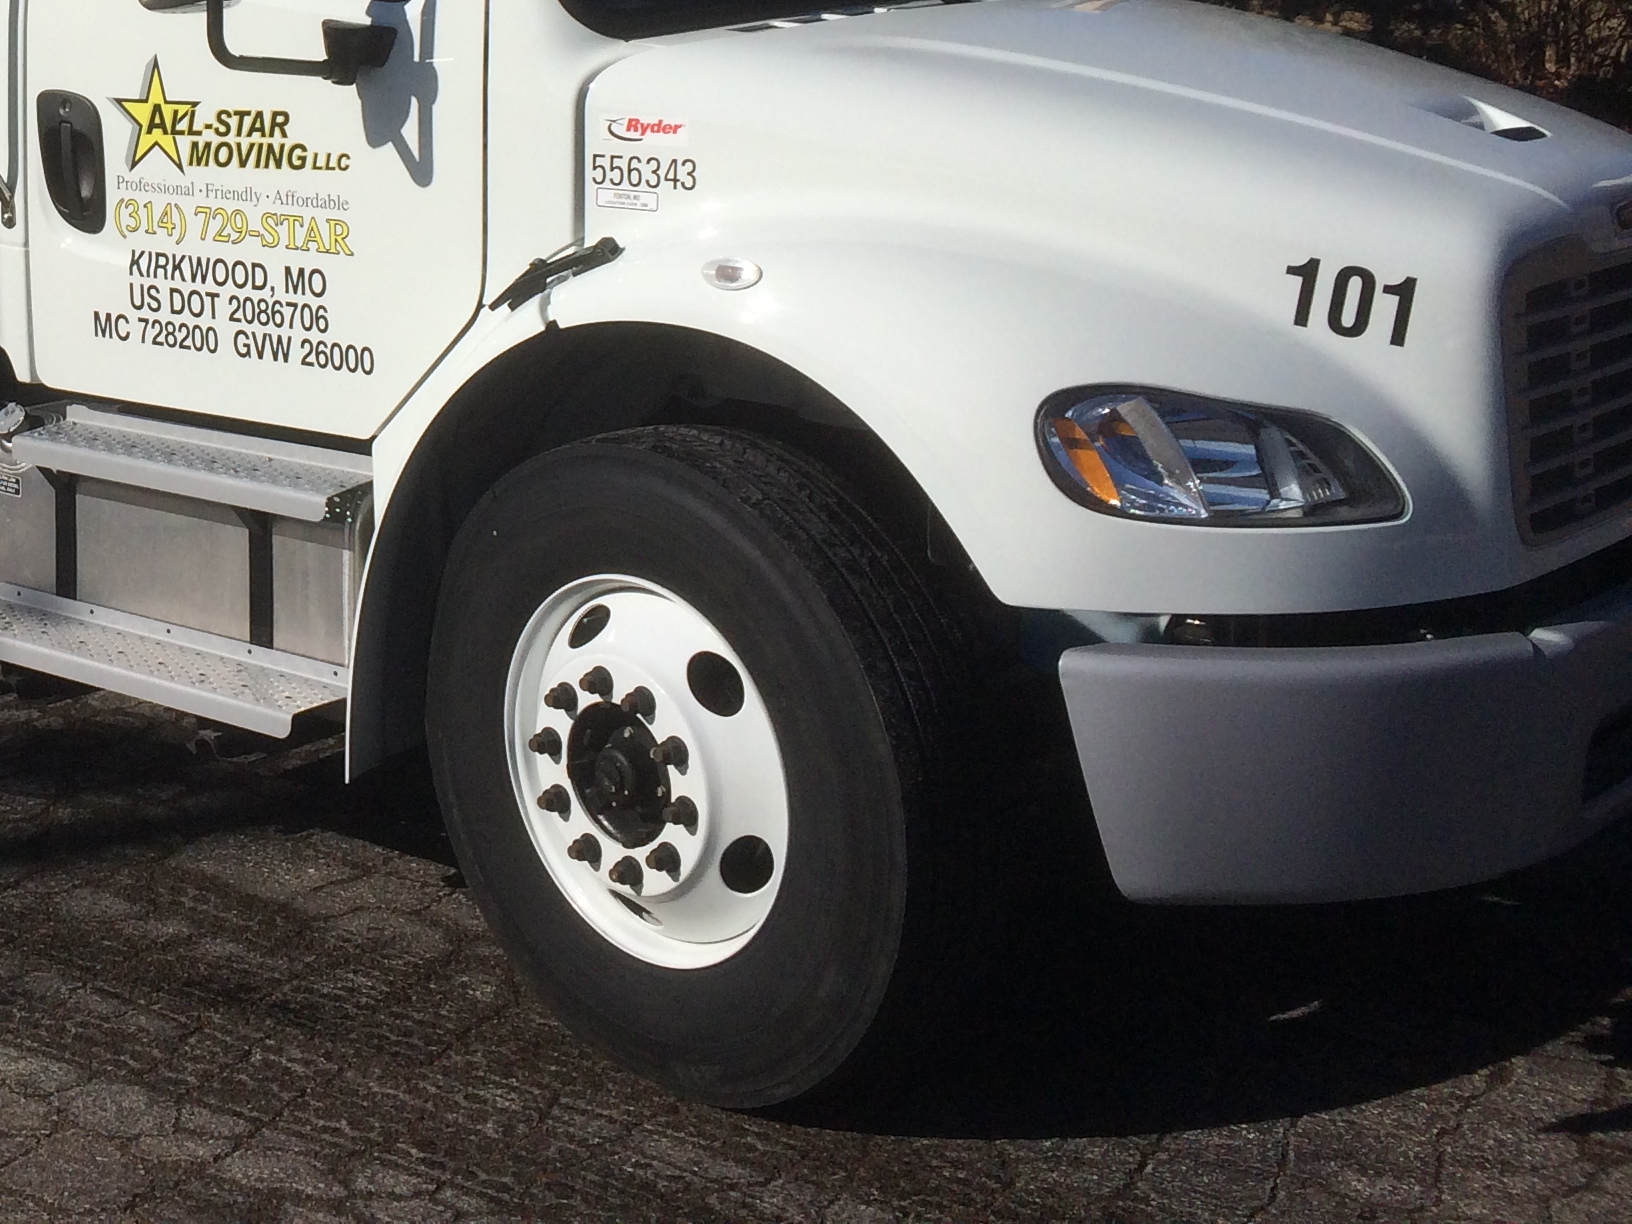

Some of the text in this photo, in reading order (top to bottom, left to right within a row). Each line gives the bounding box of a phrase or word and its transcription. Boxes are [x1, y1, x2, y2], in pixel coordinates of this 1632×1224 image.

[145, 103, 290, 139] ALL-STAR
[625, 117, 683, 136] Ryder
[187, 140, 350, 172] MOVING LLC
[591, 153, 697, 191] 556343
[116, 175, 350, 212] Professional Friendly Affordable
[114, 197, 354, 256] (314) 729-STAR
[128, 249, 327, 298] KIRKWOOD, MO
[128, 282, 330, 334] US DOT 2086706
[1285, 257, 1418, 347] 101
[93, 310, 375, 376] MC 728200 GVW 26000
